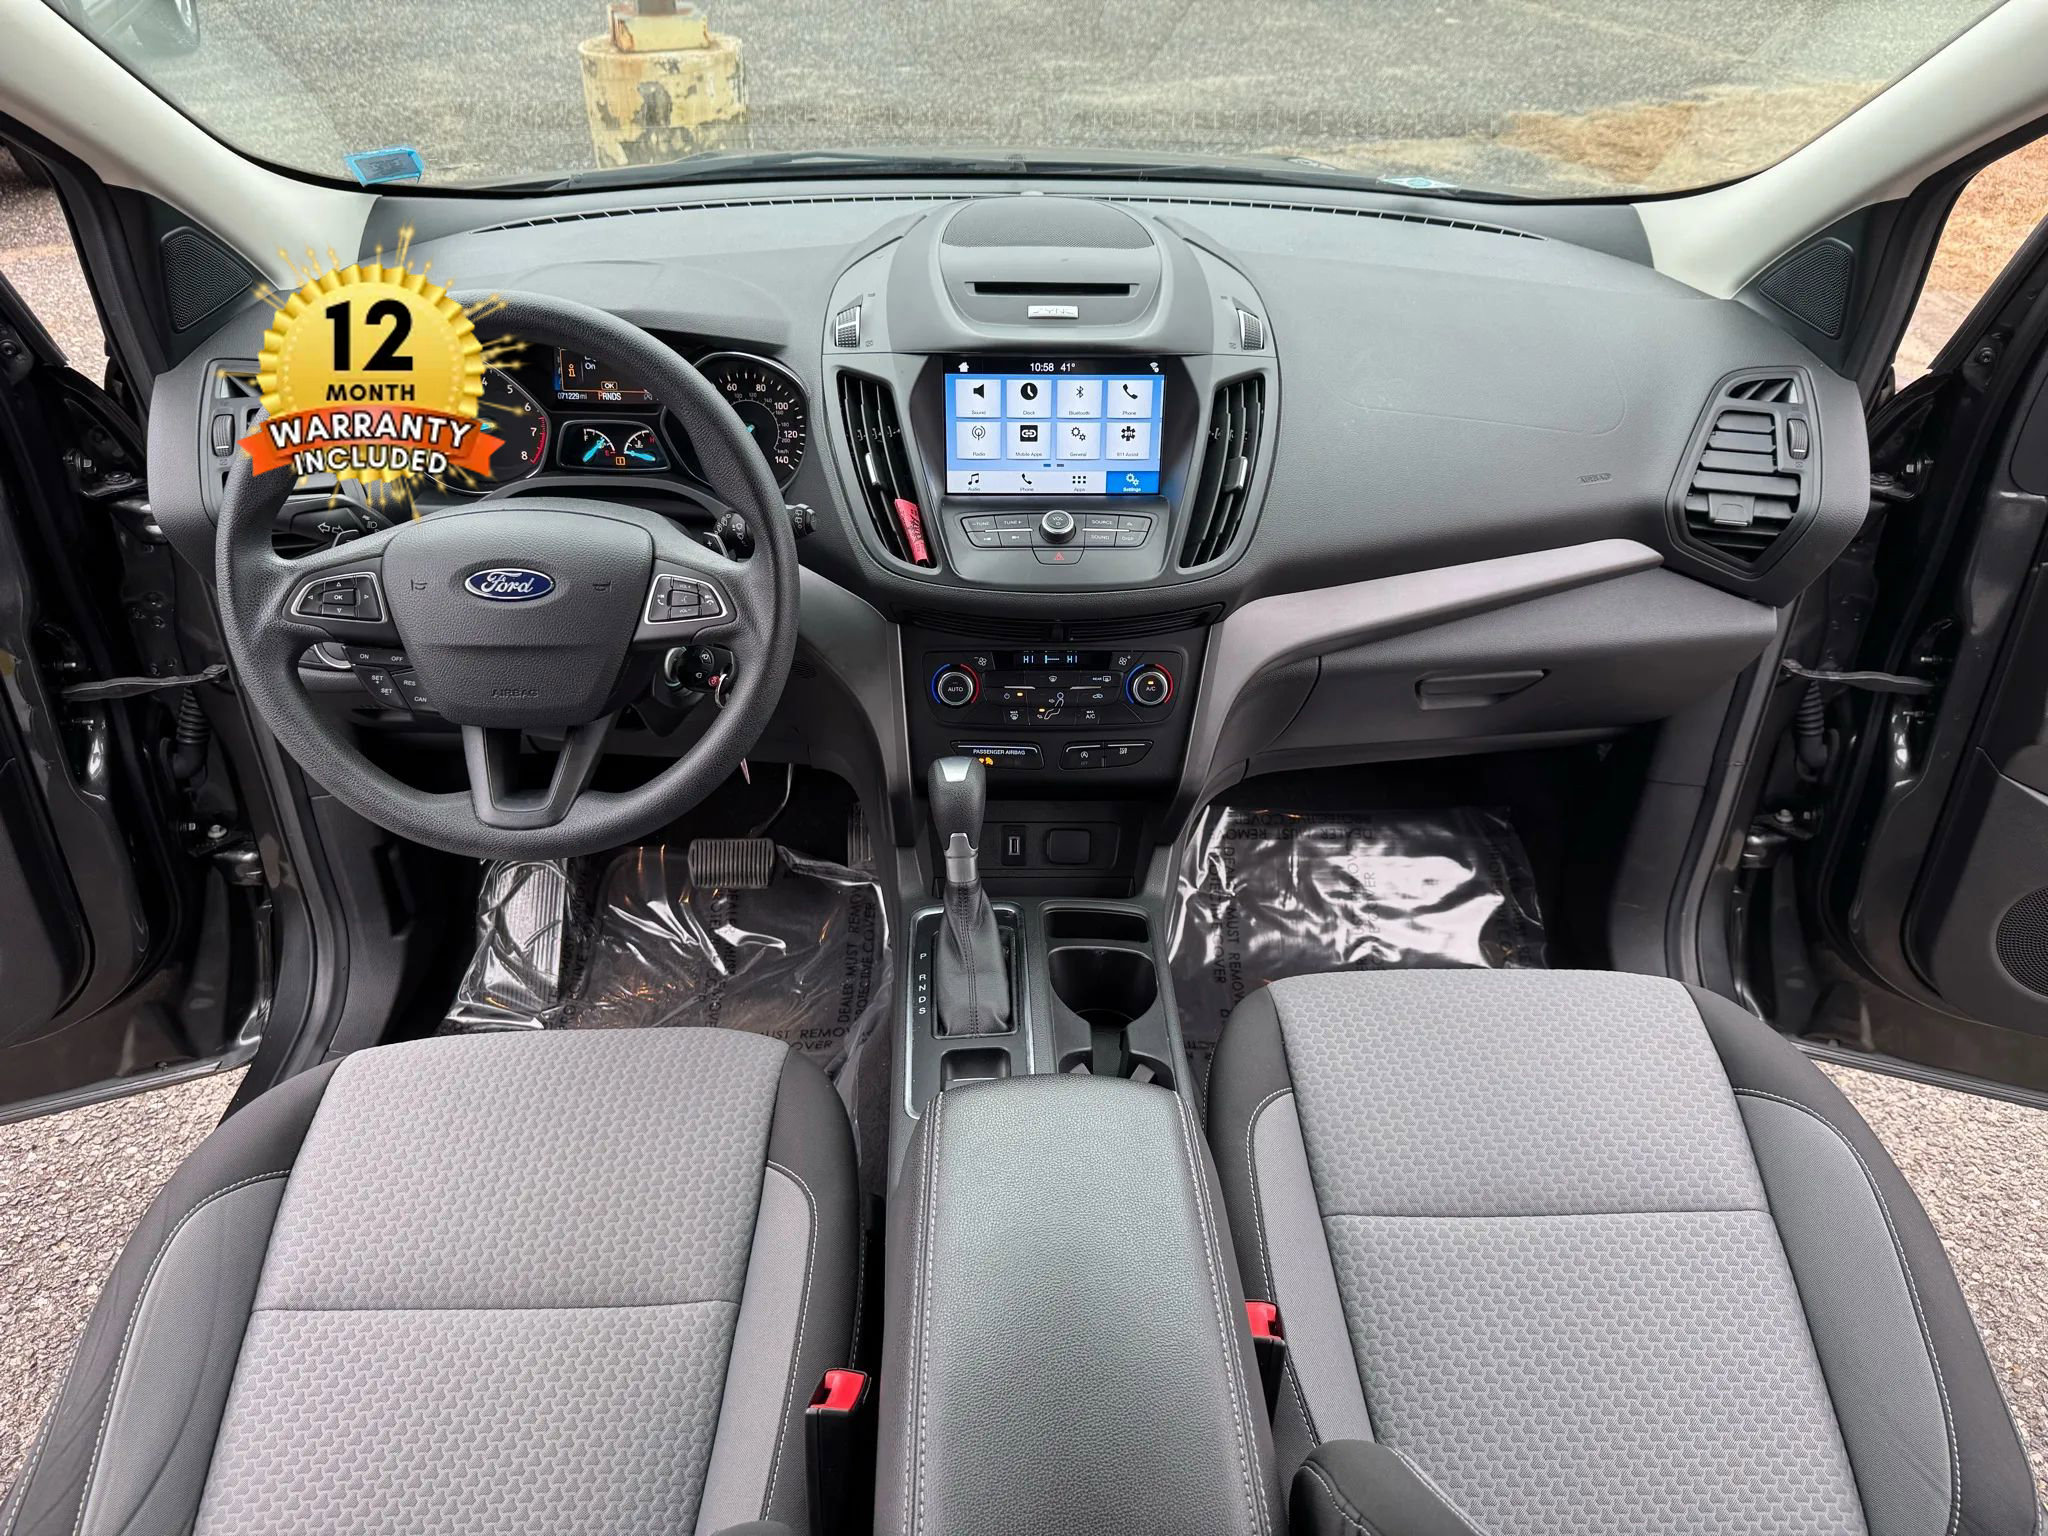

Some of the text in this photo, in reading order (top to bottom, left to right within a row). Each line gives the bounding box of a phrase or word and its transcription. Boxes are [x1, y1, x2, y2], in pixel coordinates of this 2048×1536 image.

[584, 362, 596, 370] On
[1030, 362, 1055, 372] 10:58
[506, 384, 514, 395] 5
[726, 383, 738, 391] 60
[755, 383, 767, 392] 80
[524, 402, 532, 412] 6
[774, 402, 789, 410] 100
[530, 427, 537, 437] 7
[783, 430, 798, 439] 120
[520, 451, 528, 461] 8
[774, 455, 789, 464] 140
[479, 570, 535, 595] Ford
[403, 679, 416, 687] RES
[972, 748, 1005, 756] PASSENGER
[837, 983, 854, 1023] DEALER
[846, 943, 859, 977] MUST
[918, 984, 927, 992] N
[918, 1007, 927, 1015] S
